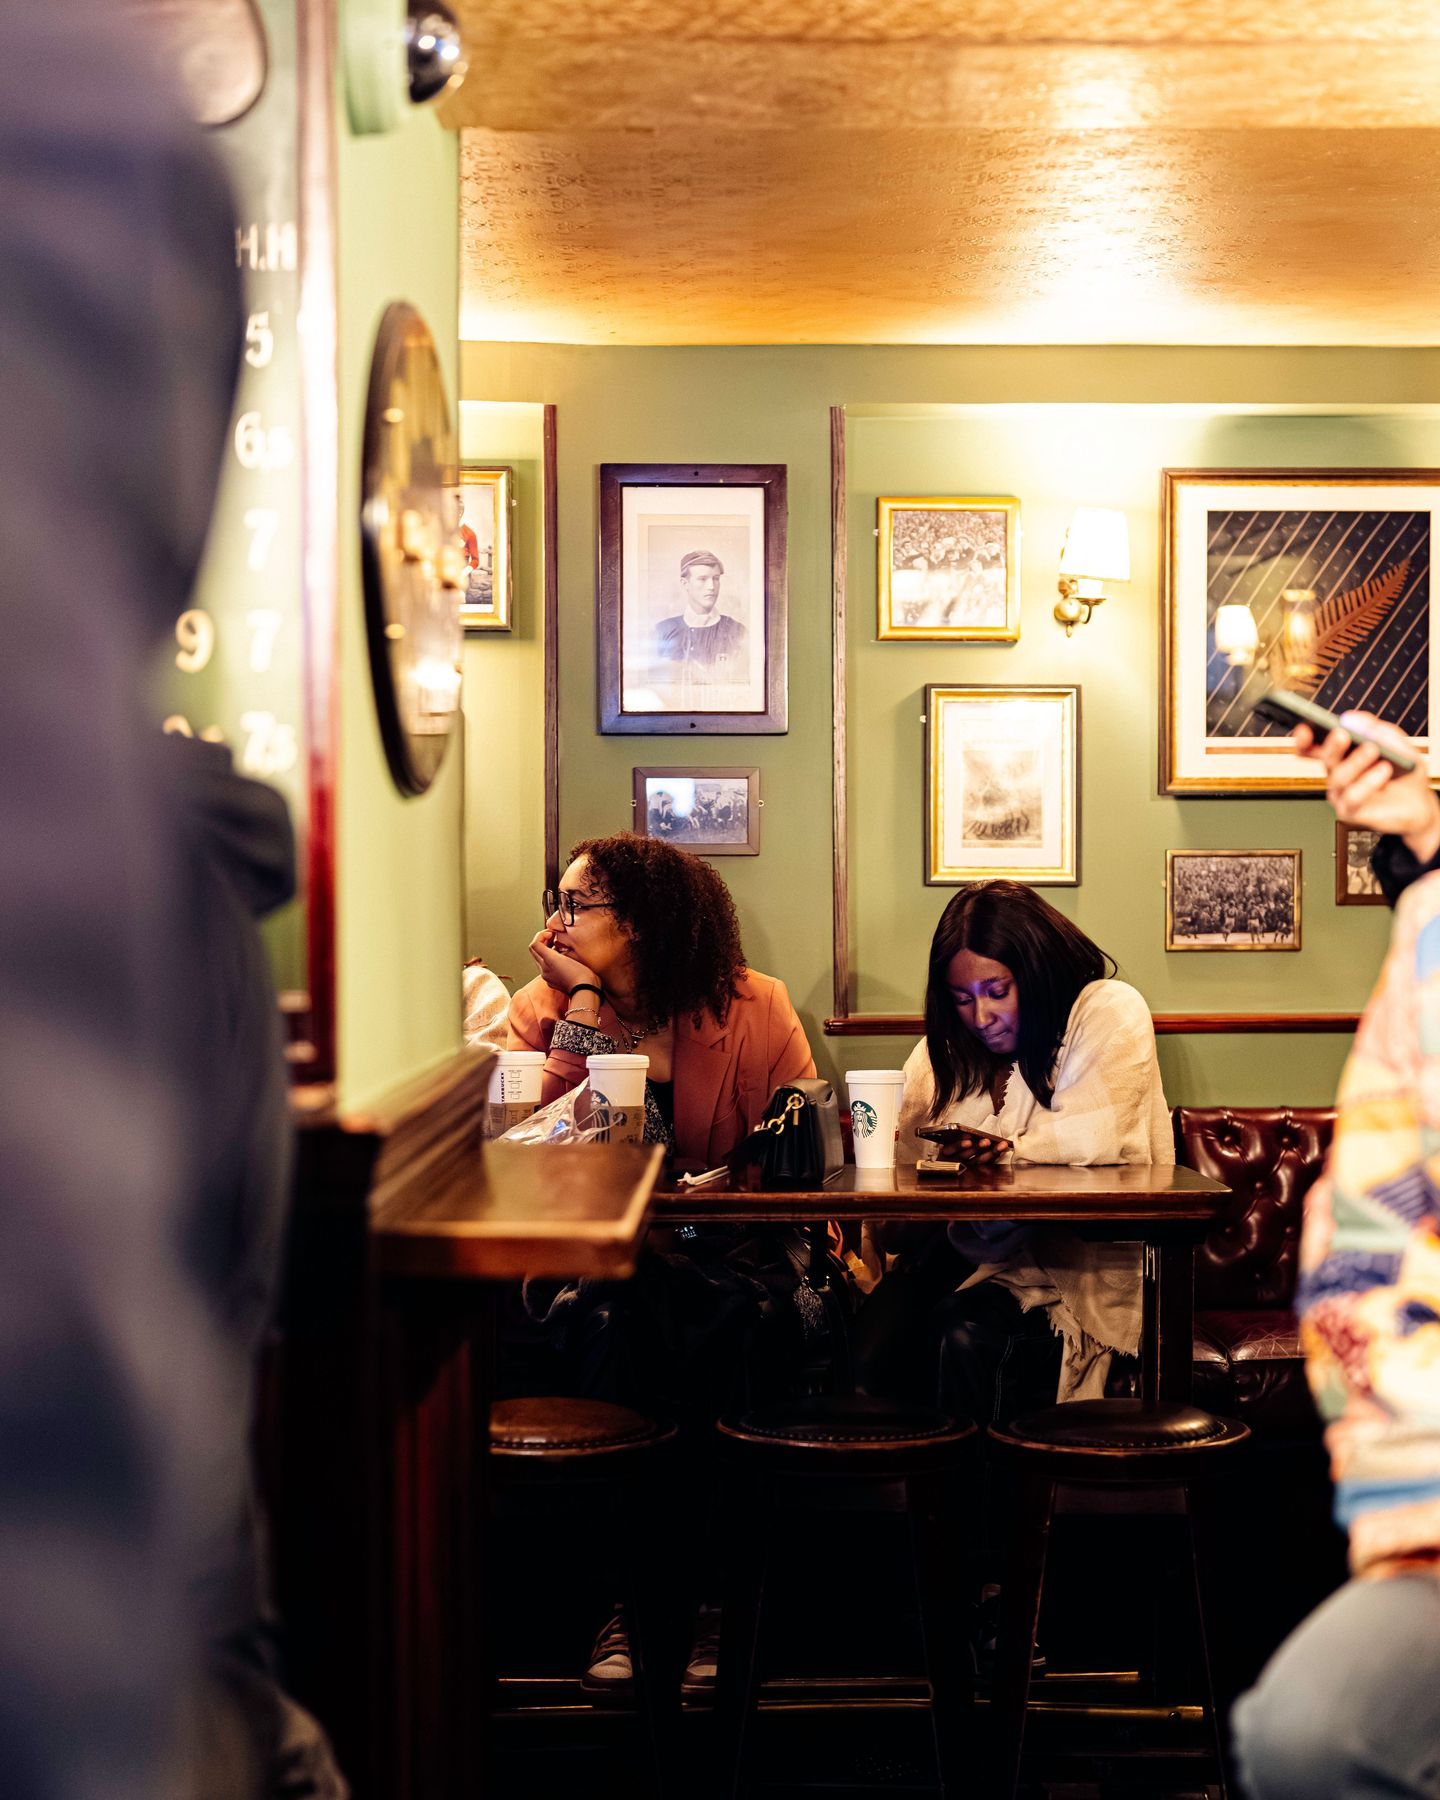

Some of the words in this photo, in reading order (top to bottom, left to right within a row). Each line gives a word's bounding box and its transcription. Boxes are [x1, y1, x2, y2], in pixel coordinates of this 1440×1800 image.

[245, 309, 274, 369] 5
[243, 507, 279, 572] 7
[175, 608, 215, 673] 9
[246, 608, 284, 673] 7
